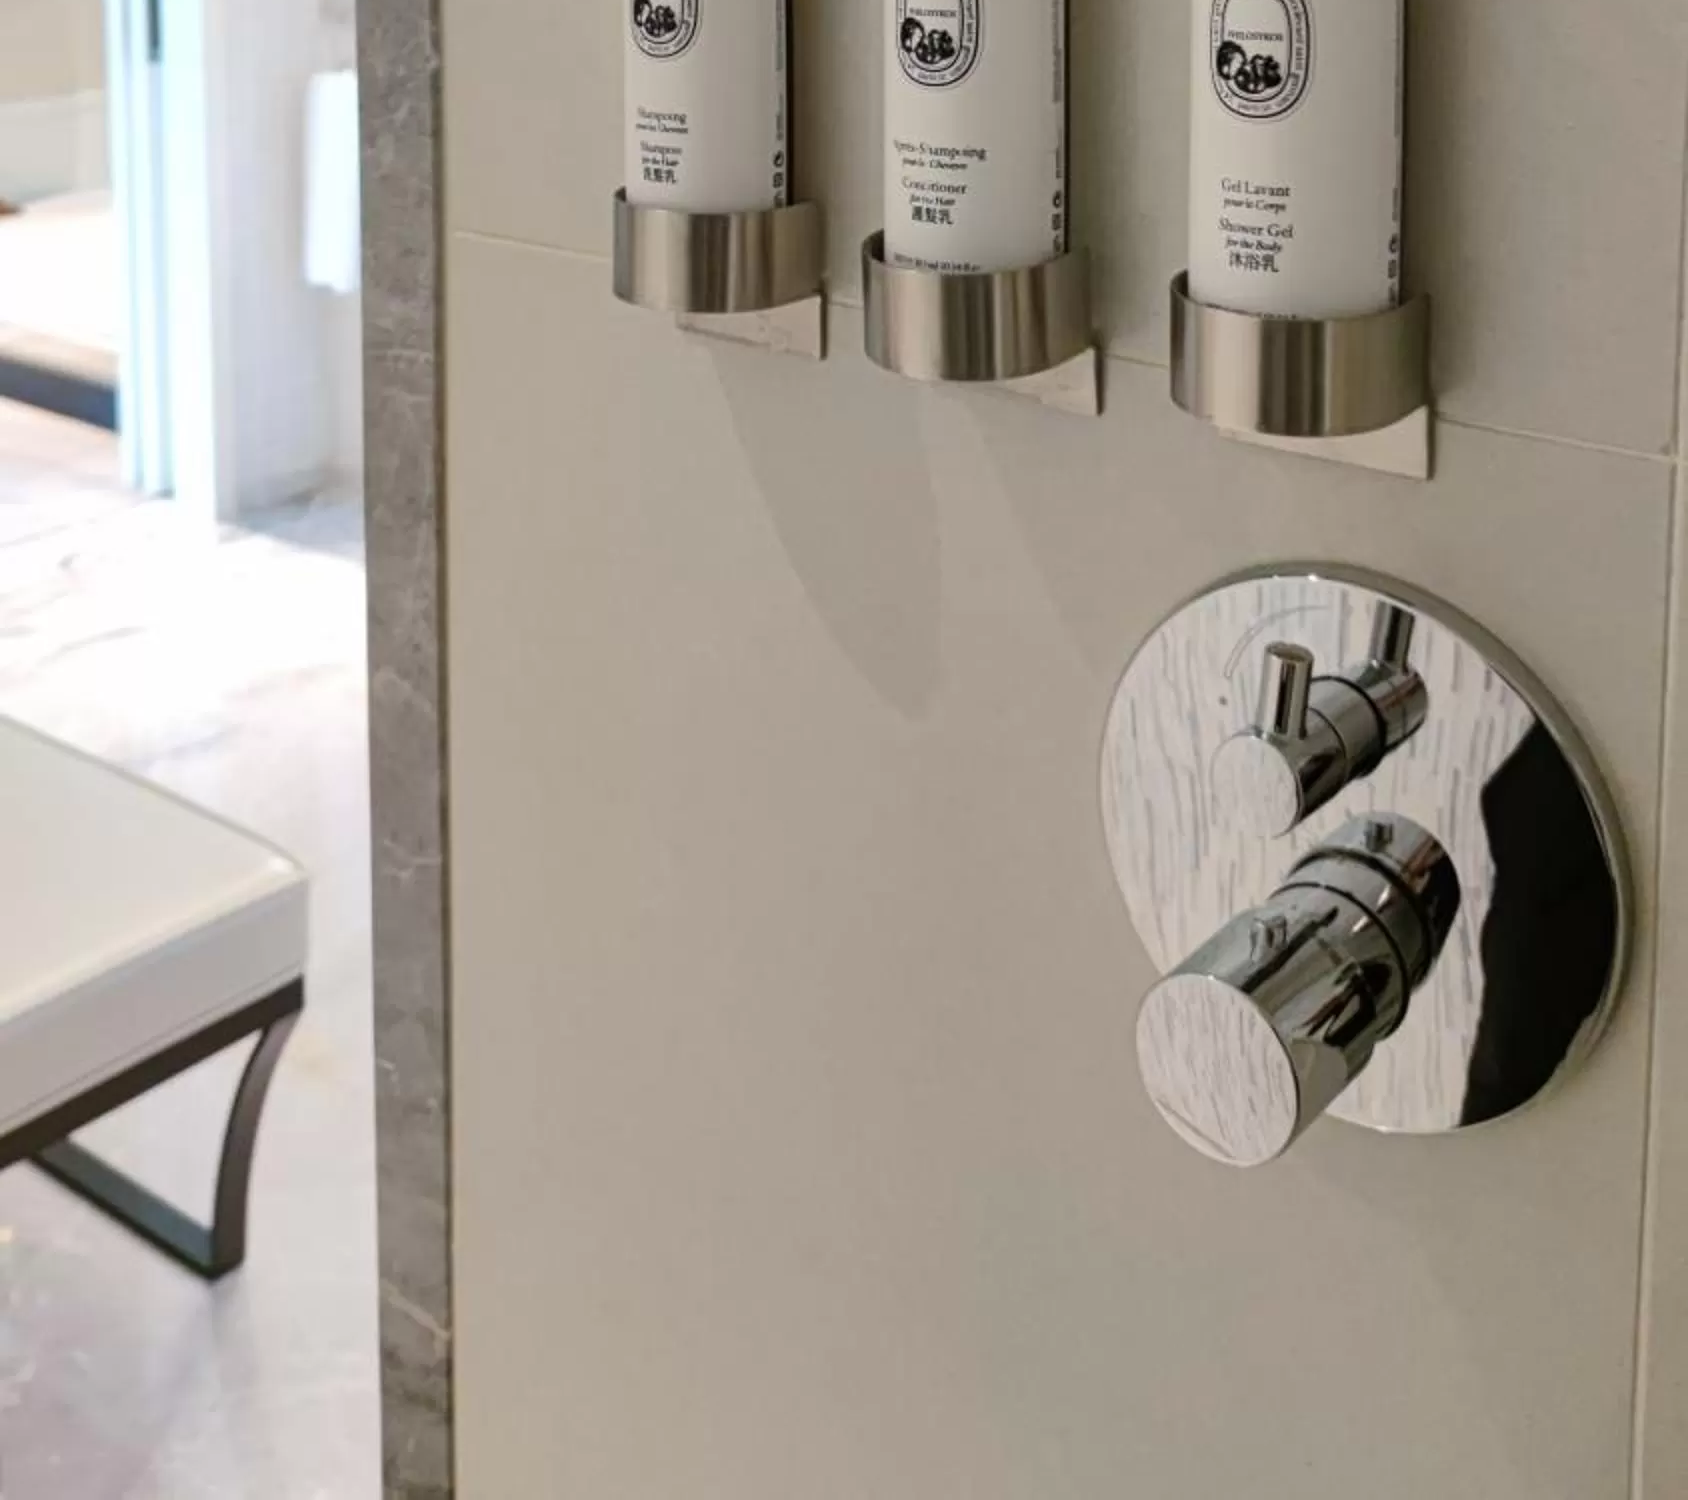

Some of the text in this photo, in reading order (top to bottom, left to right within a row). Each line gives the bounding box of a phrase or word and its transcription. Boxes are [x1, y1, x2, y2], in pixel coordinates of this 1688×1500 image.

[1220, 178, 1291, 197] Gel Lavant
[1218, 217, 1294, 239] Shower Gel
[1255, 239, 1283, 253] Body
